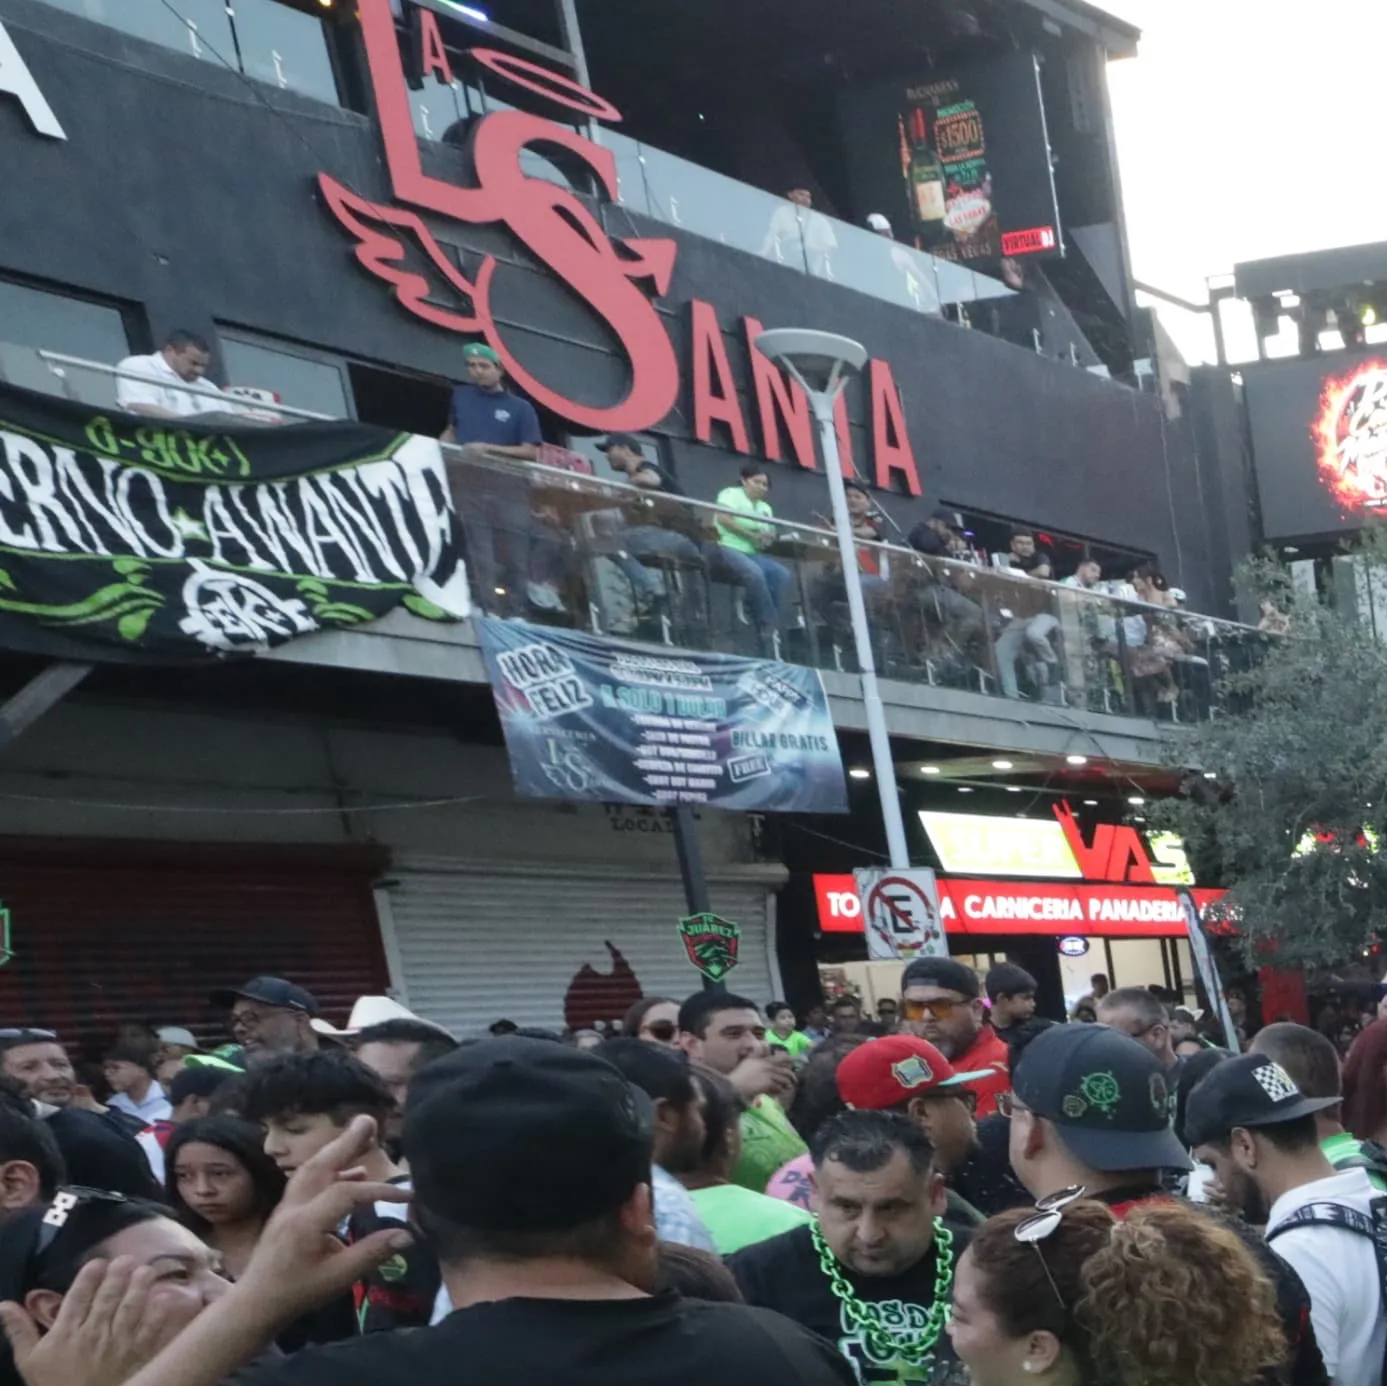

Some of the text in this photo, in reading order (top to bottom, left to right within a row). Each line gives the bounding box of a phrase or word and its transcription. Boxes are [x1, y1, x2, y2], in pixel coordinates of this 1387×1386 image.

[500, 644, 572, 684] HORA
[528, 679, 592, 717] FELIZ
[779, 734, 829, 752] GRATIS
[964, 894, 1083, 921] CARNICERIA
